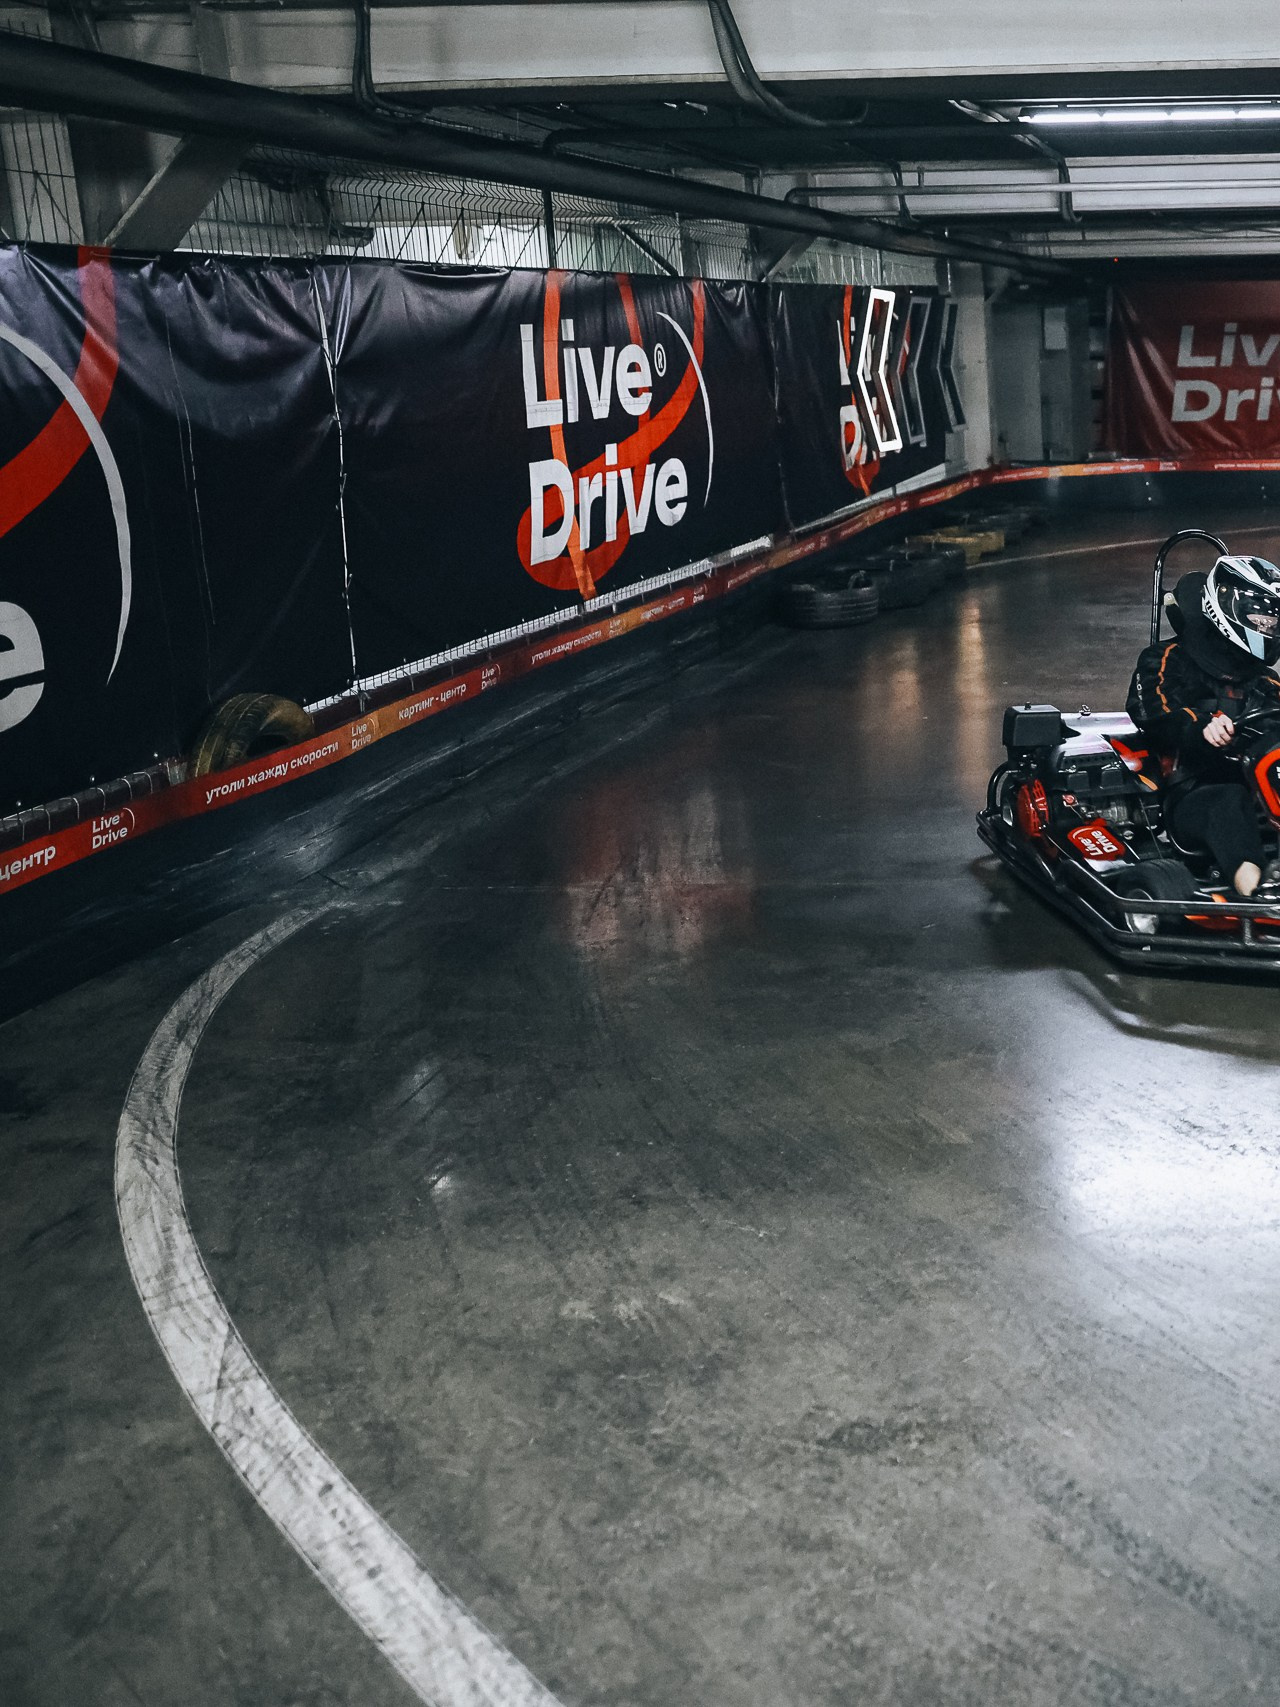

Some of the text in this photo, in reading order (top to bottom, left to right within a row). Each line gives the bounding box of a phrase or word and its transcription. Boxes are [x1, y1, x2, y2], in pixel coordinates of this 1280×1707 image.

[528, 443, 688, 566] Drive
[398, 698, 434, 721] картинг
[440, 683, 467, 703] центр
[351, 723, 368, 737] Live
[351, 733, 372, 750] Drive
[205, 741, 339, 804] утоли жажду скорости
[92, 812, 120, 834] Live
[92, 825, 128, 849] Drive
[1090, 829, 1118, 853] Drive
